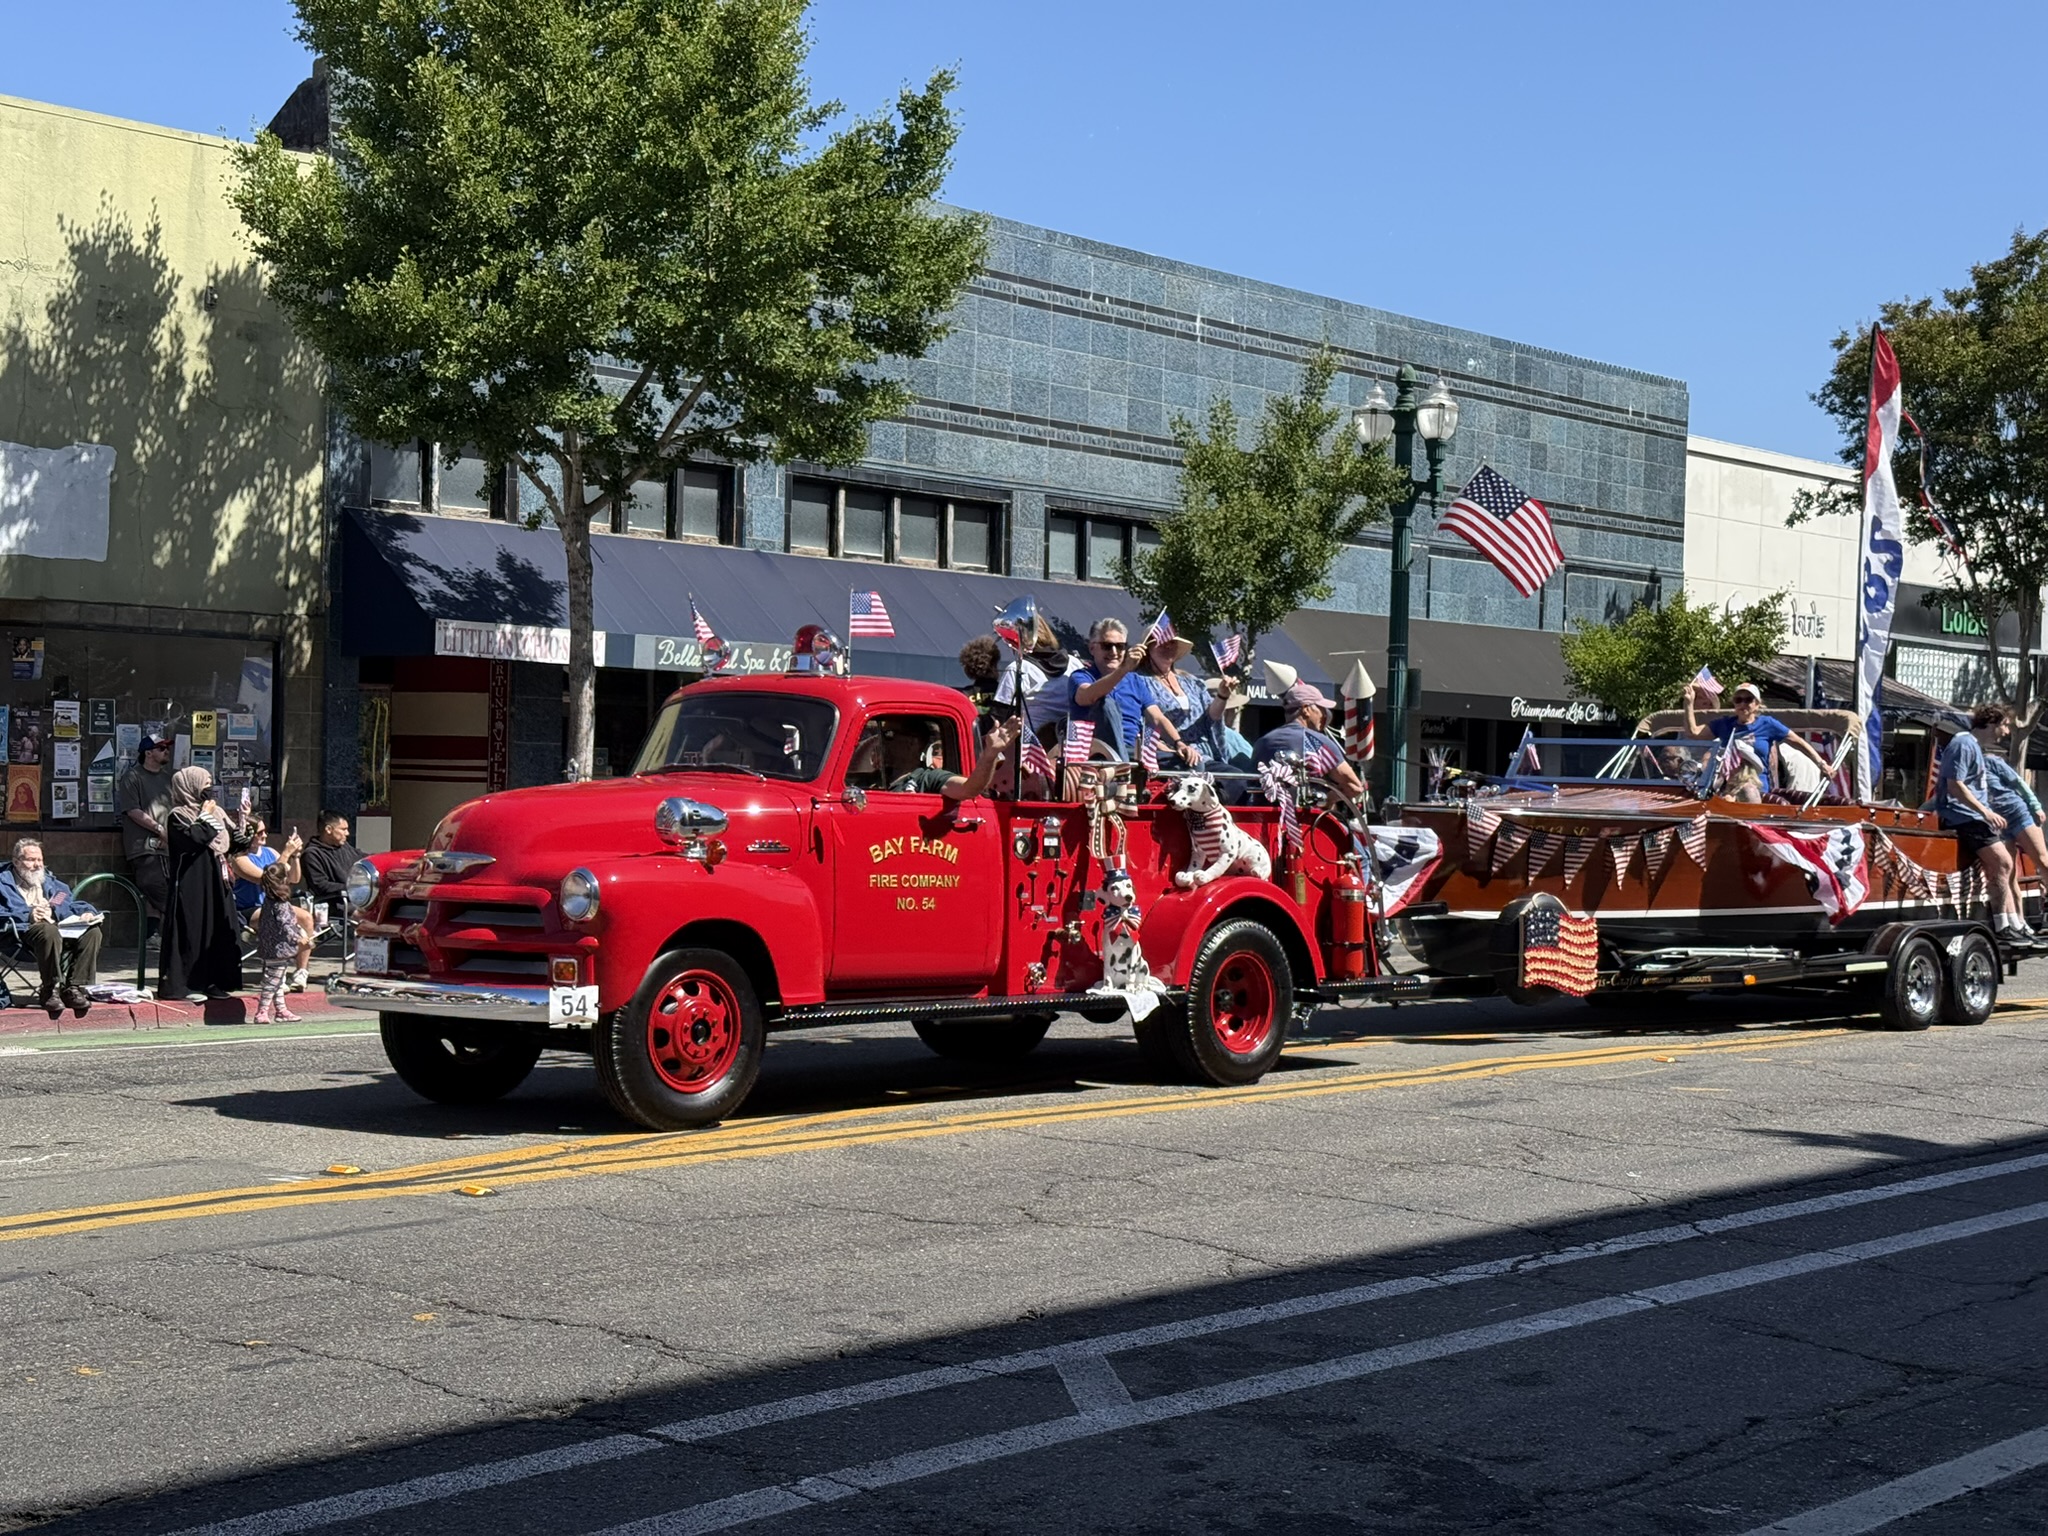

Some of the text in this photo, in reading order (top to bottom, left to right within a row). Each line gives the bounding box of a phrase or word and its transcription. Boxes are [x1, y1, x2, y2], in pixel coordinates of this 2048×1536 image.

[443, 626, 494, 655] LITTLE
[658, 639, 702, 668] Bella
[740, 648, 765, 675] Spa
[769, 648, 782, 671] &
[1246, 685, 1268, 699] NAIL
[196, 714, 213, 722] IMP
[1511, 696, 1566, 721] Triumphant
[1565, 701, 1585, 724] Life
[869, 836, 959, 865] BAY FARM
[869, 874, 960, 888] FIRE COMPANY
[896, 897, 936, 910] NO. 54
[561, 995, 588, 1016] 54
